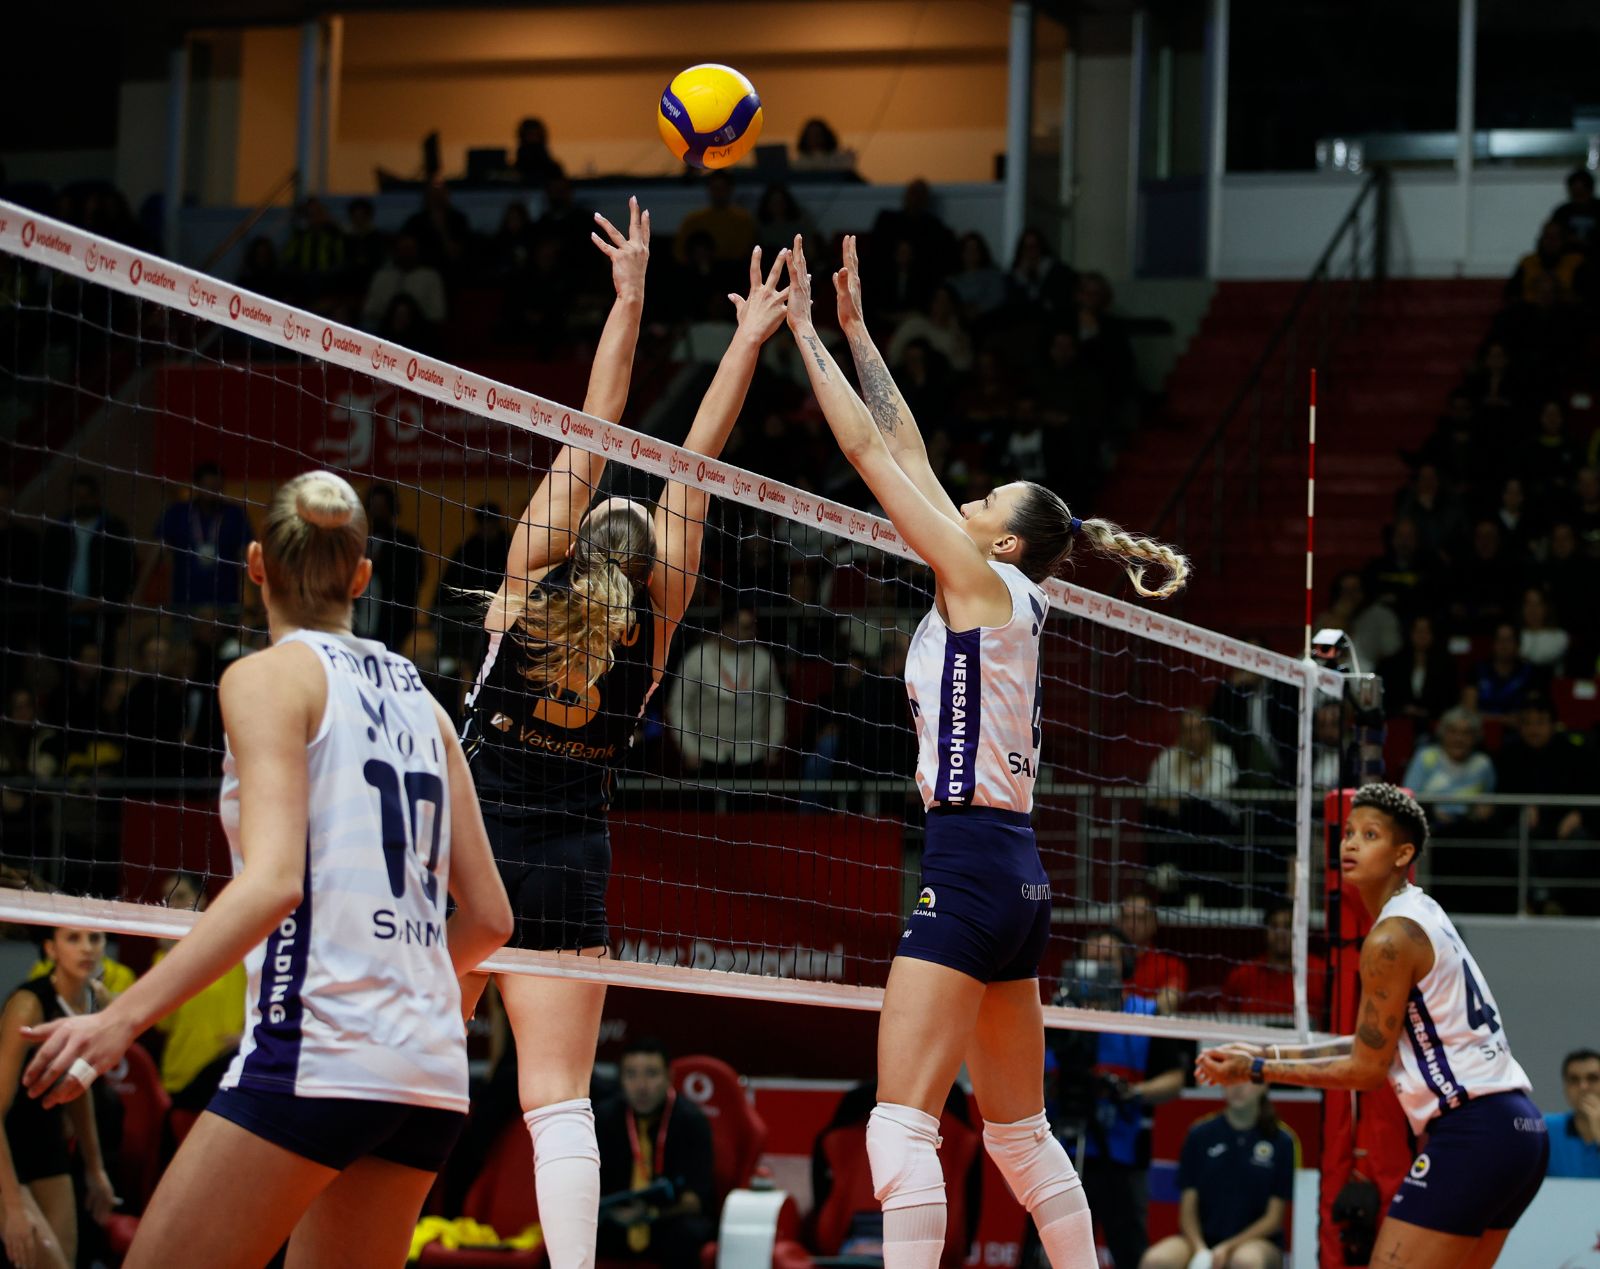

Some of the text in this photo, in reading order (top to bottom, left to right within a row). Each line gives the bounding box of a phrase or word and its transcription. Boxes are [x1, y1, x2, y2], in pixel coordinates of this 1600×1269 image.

[36, 233, 72, 255] vodafone
[100, 255, 117, 273] TVF
[143, 268, 176, 291] vodafone
[201, 290, 217, 308] TVF
[241, 306, 272, 326] vodafone
[296, 325, 311, 342] TVF
[333, 337, 362, 356] vodafone
[383, 354, 398, 371] TVF
[418, 368, 444, 387] vodafone
[463, 385, 478, 402] TVF
[496, 396, 521, 414] vodafone
[540, 412, 553, 427] TVF
[570, 421, 594, 439] vodafone
[611, 436, 623, 453] TVF
[639, 446, 662, 463] vodafone
[678, 459, 690, 474] TVF
[705, 468, 726, 485] vodafone
[741, 481, 752, 496] TVF
[766, 489, 786, 505] vodafone
[952, 653, 967, 735] NERSAN
[363, 758, 444, 911] 10
[268, 908, 297, 1025] OLDİNG
[372, 909, 445, 947] SNM
[1462, 957, 1500, 1034] 4
